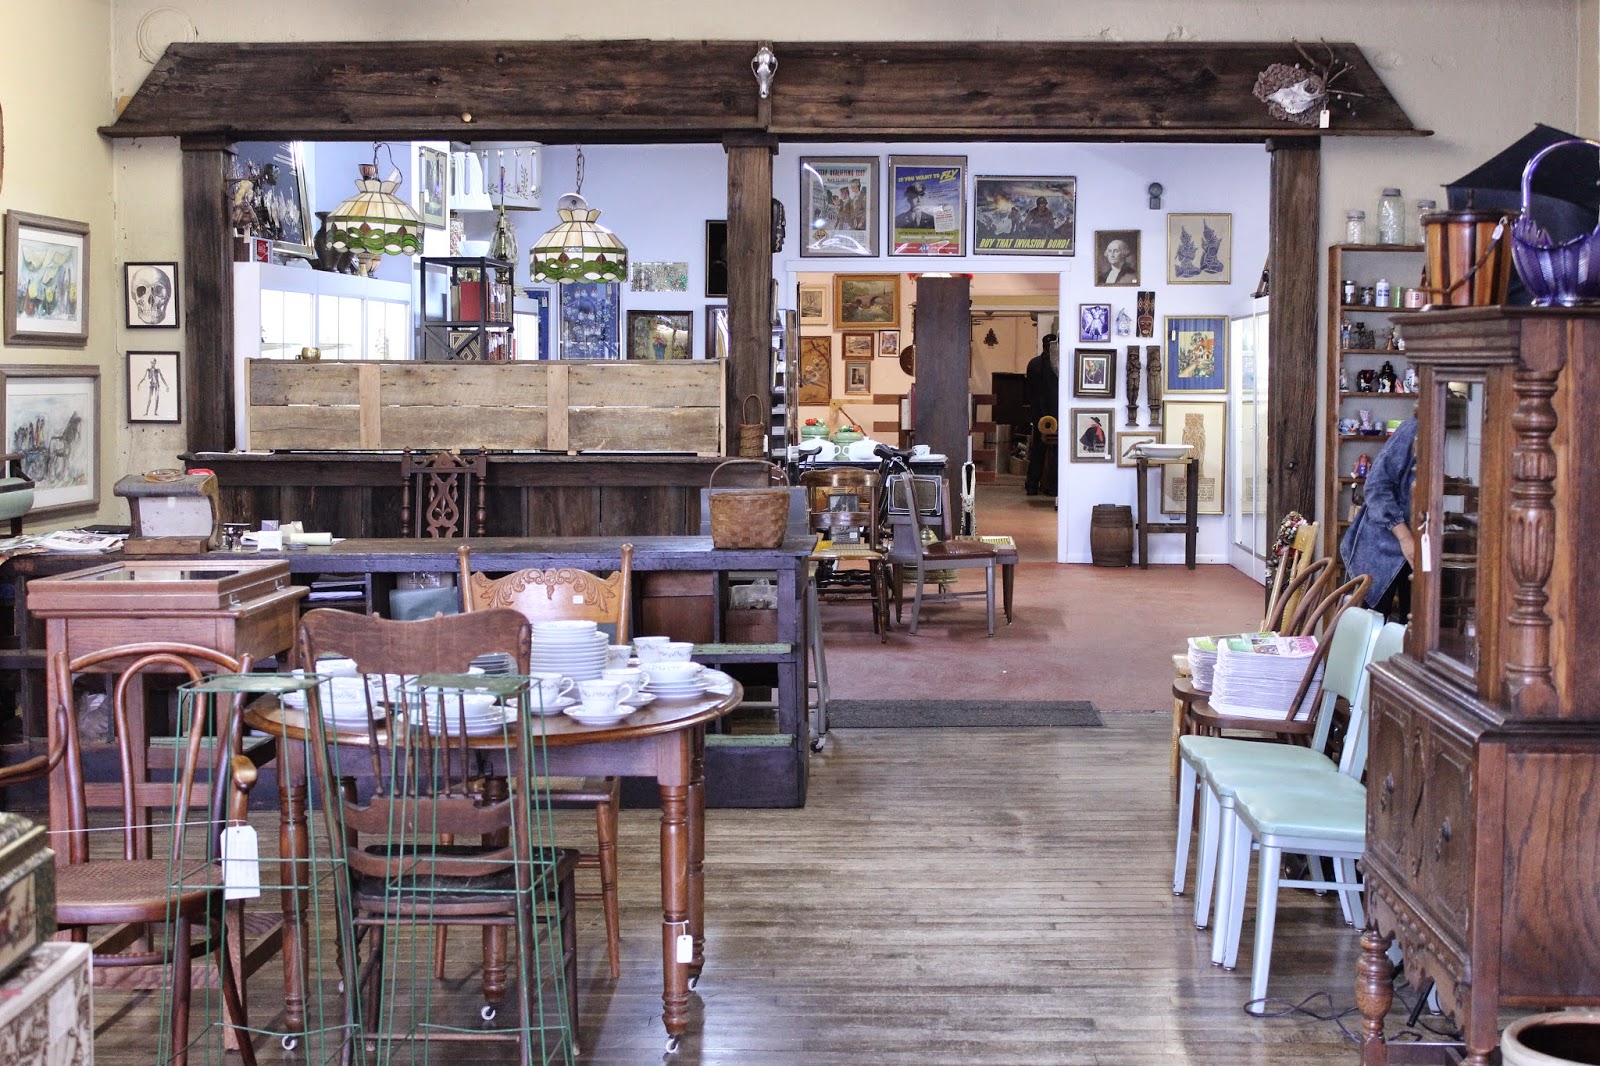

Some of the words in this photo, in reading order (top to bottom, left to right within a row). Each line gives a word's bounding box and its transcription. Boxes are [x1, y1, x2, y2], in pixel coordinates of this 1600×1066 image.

[940, 169, 959, 181] FLY
[980, 239, 995, 248] BUY
[995, 239, 1014, 248] THAT
[1014, 239, 1046, 248] INVASION
[1047, 239, 1070, 249] BOND!
